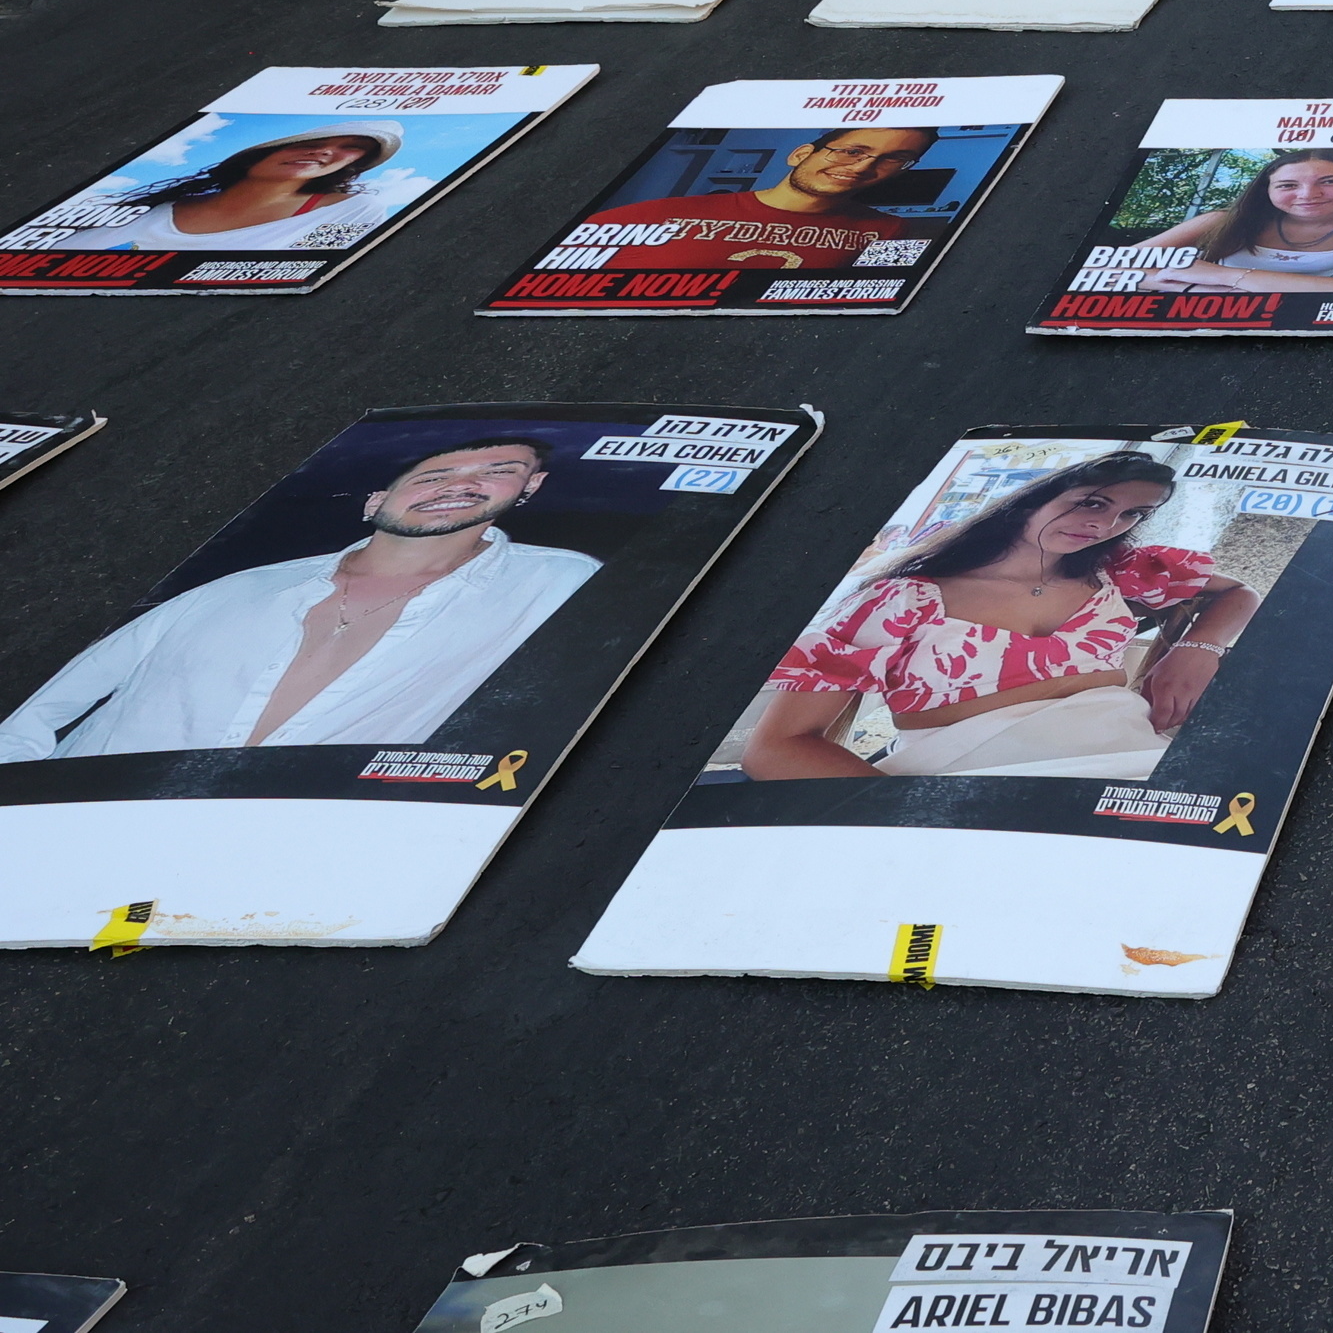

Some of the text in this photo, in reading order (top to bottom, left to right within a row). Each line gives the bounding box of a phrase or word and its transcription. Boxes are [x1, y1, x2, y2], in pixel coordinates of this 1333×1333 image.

[341, 71, 509, 83] אמילי תהילה דמארי
[308, 83, 503, 95] EMILY TEHILA DAMARI
[830, 83, 938, 95] תמיר נמרודי
[335, 98, 398, 110] (28)
[802, 95, 945, 109] TAMIR NIMRODI
[1305, 102, 1332, 115] לוי
[841, 108, 882, 122] (19)
[26, 205, 151, 228] BRING
[560, 223, 682, 246] BRING
[533, 247, 621, 270] HIM
[1082, 245, 1199, 269] BRING
[504, 270, 740, 298] HOME NOW!
[1066, 269, 1146, 292] HER
[1050, 293, 1284, 319] HOME NOW!
[654, 419, 786, 441] אליה כהן
[594, 440, 766, 464] ELIYA COHEN
[1211, 437, 1293, 460] גלבוע
[673, 467, 738, 492] (27)
[1182, 461, 1287, 484] DANIELA
[1239, 488, 1304, 515] (20)
[914, 1239, 1181, 1279] אריאל ביבס
[494, 1299, 549, 1330] 274
[889, 1293, 1157, 1329] ARIEL BIBAS
